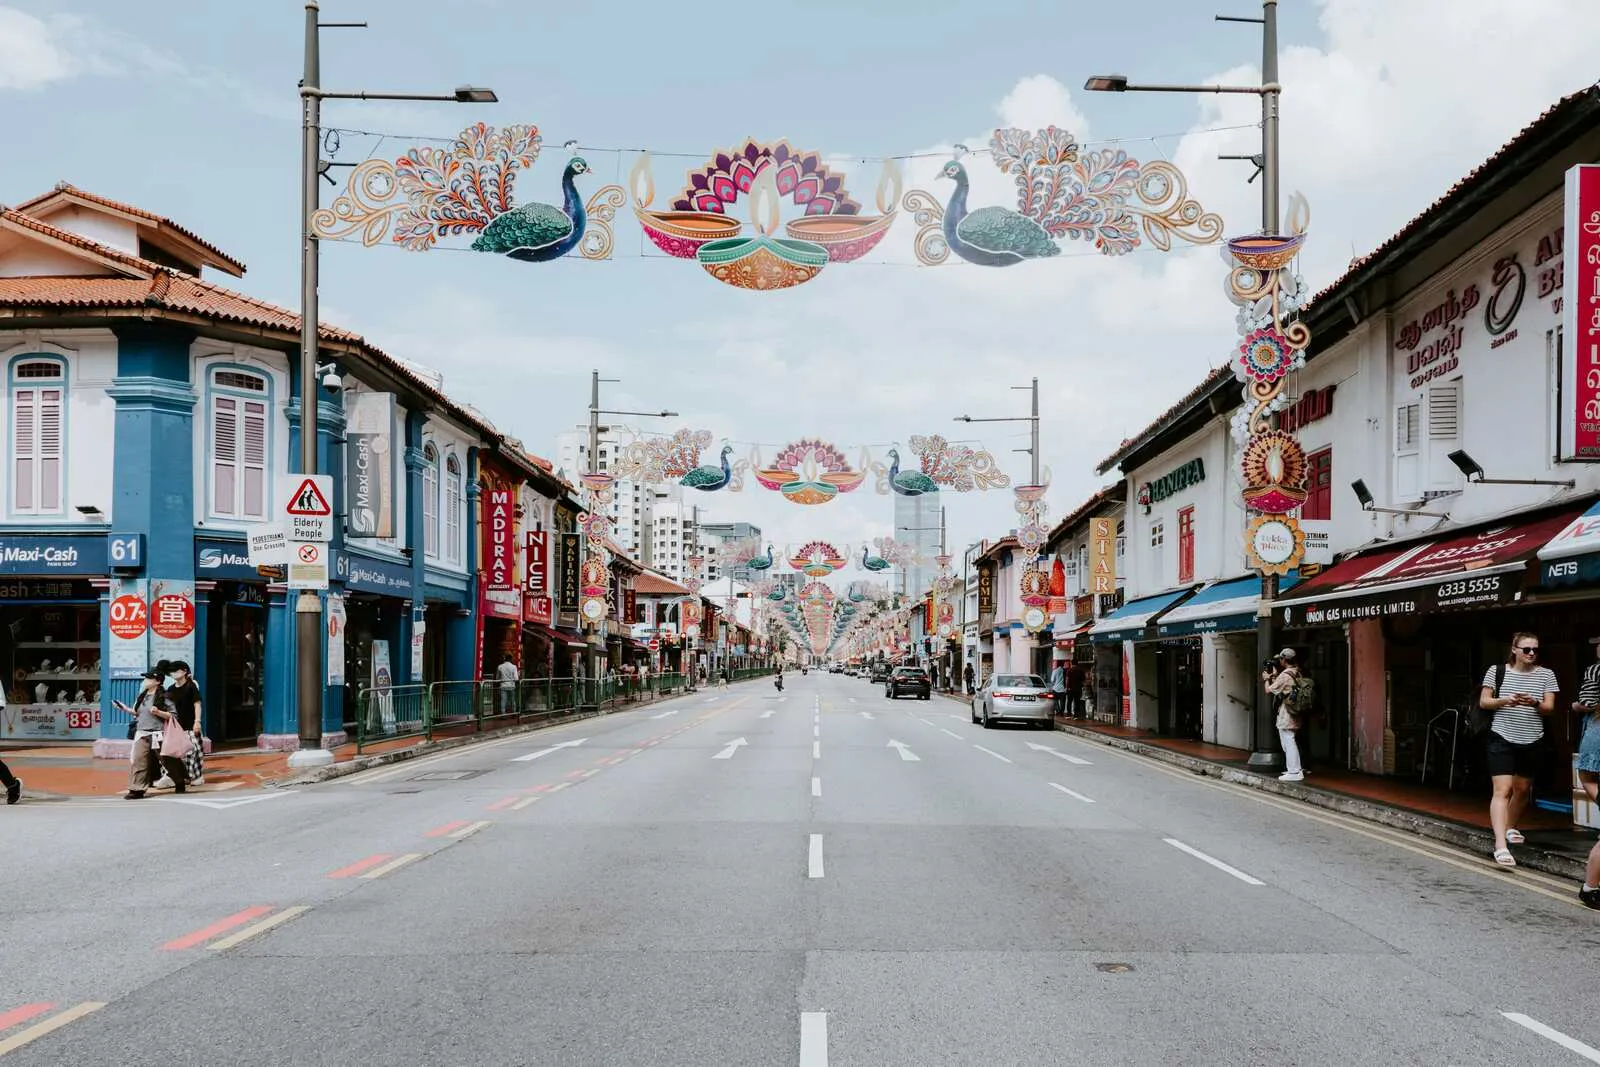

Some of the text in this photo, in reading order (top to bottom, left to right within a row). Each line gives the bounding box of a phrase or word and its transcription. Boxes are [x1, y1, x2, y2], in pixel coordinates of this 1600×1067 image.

[356, 438, 369, 507] Maxi-Cash
[1152, 458, 1205, 502] HANIFFA
[294, 518, 323, 529] Elderly
[295, 530, 322, 539] People
[252, 533, 285, 543] PEDESTRIANS
[492, 492, 508, 583] MADURAS
[4, 546, 78, 561] Maxi-Cash
[111, 539, 137, 561] 61
[530, 532, 543, 590] NICE
[1095, 521, 1111, 592] STAR
[337, 556, 349, 577] 61
[1549, 561, 1578, 578] NETS
[981, 577, 991, 605] GMT
[1438, 577, 1500, 597] 6333 5555
[159, 598, 187, 623] 當
[531, 598, 547, 615] NICE
[1306, 601, 1416, 623] UNION GAS HOLDINGS LIMITED
